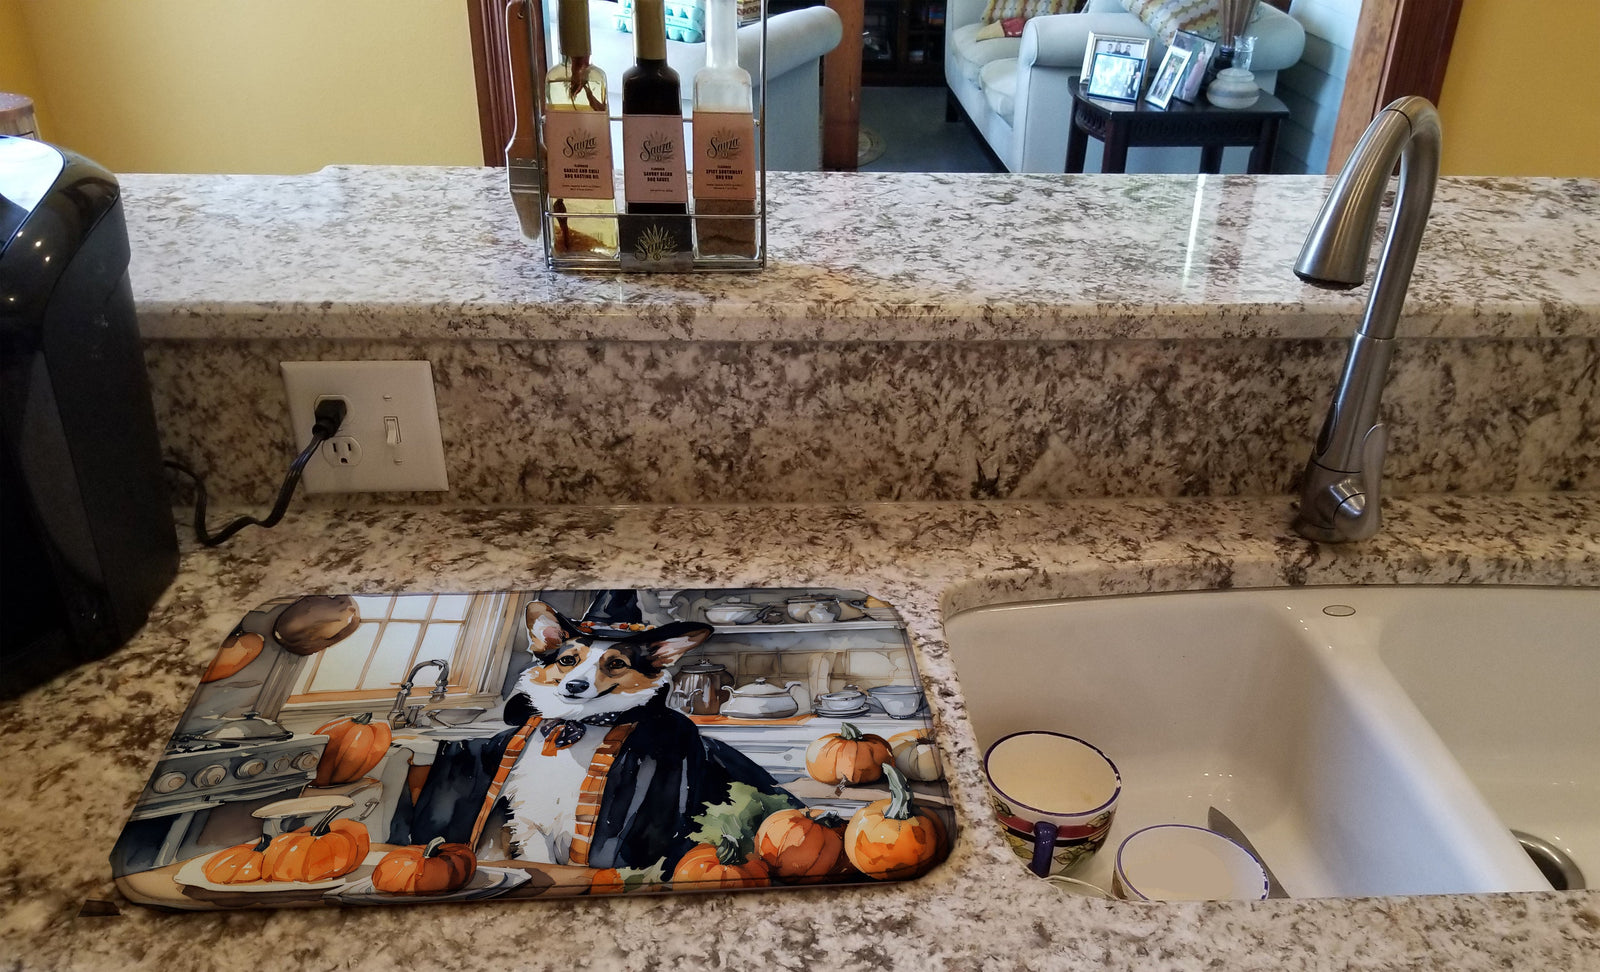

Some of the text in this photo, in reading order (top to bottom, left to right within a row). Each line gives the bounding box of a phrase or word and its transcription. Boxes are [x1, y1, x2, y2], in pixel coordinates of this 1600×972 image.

[563, 136, 596, 158] Sauza
[640, 139, 673, 161] Sauza
[706, 137, 740, 159] Sauza
